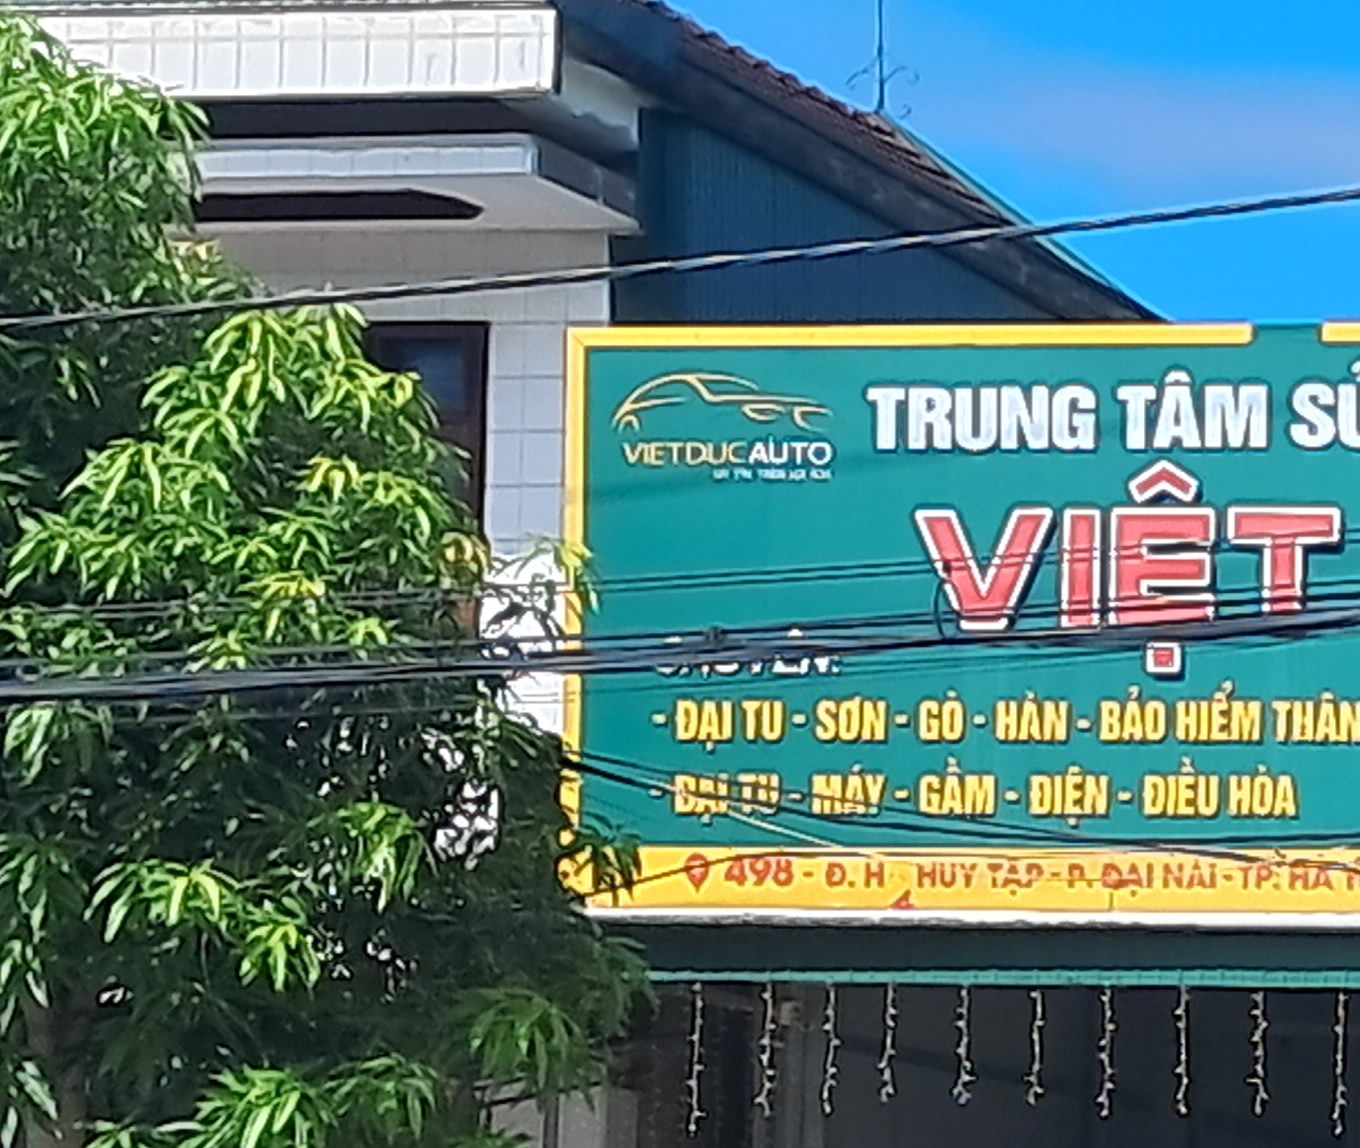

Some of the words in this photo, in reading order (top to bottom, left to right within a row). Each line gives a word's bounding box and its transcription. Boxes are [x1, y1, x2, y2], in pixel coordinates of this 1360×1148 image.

[866, 384, 1097, 452] TRUNG
[1116, 370, 1268, 451] TÂM
[913, 461, 1344, 677] VIỆT
[675, 699, 733, 752] ĐẠI
[741, 699, 786, 743] TU
[815, 695, 888, 743] SƠN
[919, 689, 965, 743] GÒ
[995, 691, 1068, 743] HÀN
[1099, 684, 1167, 743] BẢO
[1175, 680, 1262, 743] HIỂM
[1028, 765, 1110, 828] ĐIỆN
[1143, 756, 1220, 817] ĐIỀU
[1229, 765, 1297, 817] HÒA
[724, 858, 795, 888] 498
[916, 862, 977, 889] HUY
